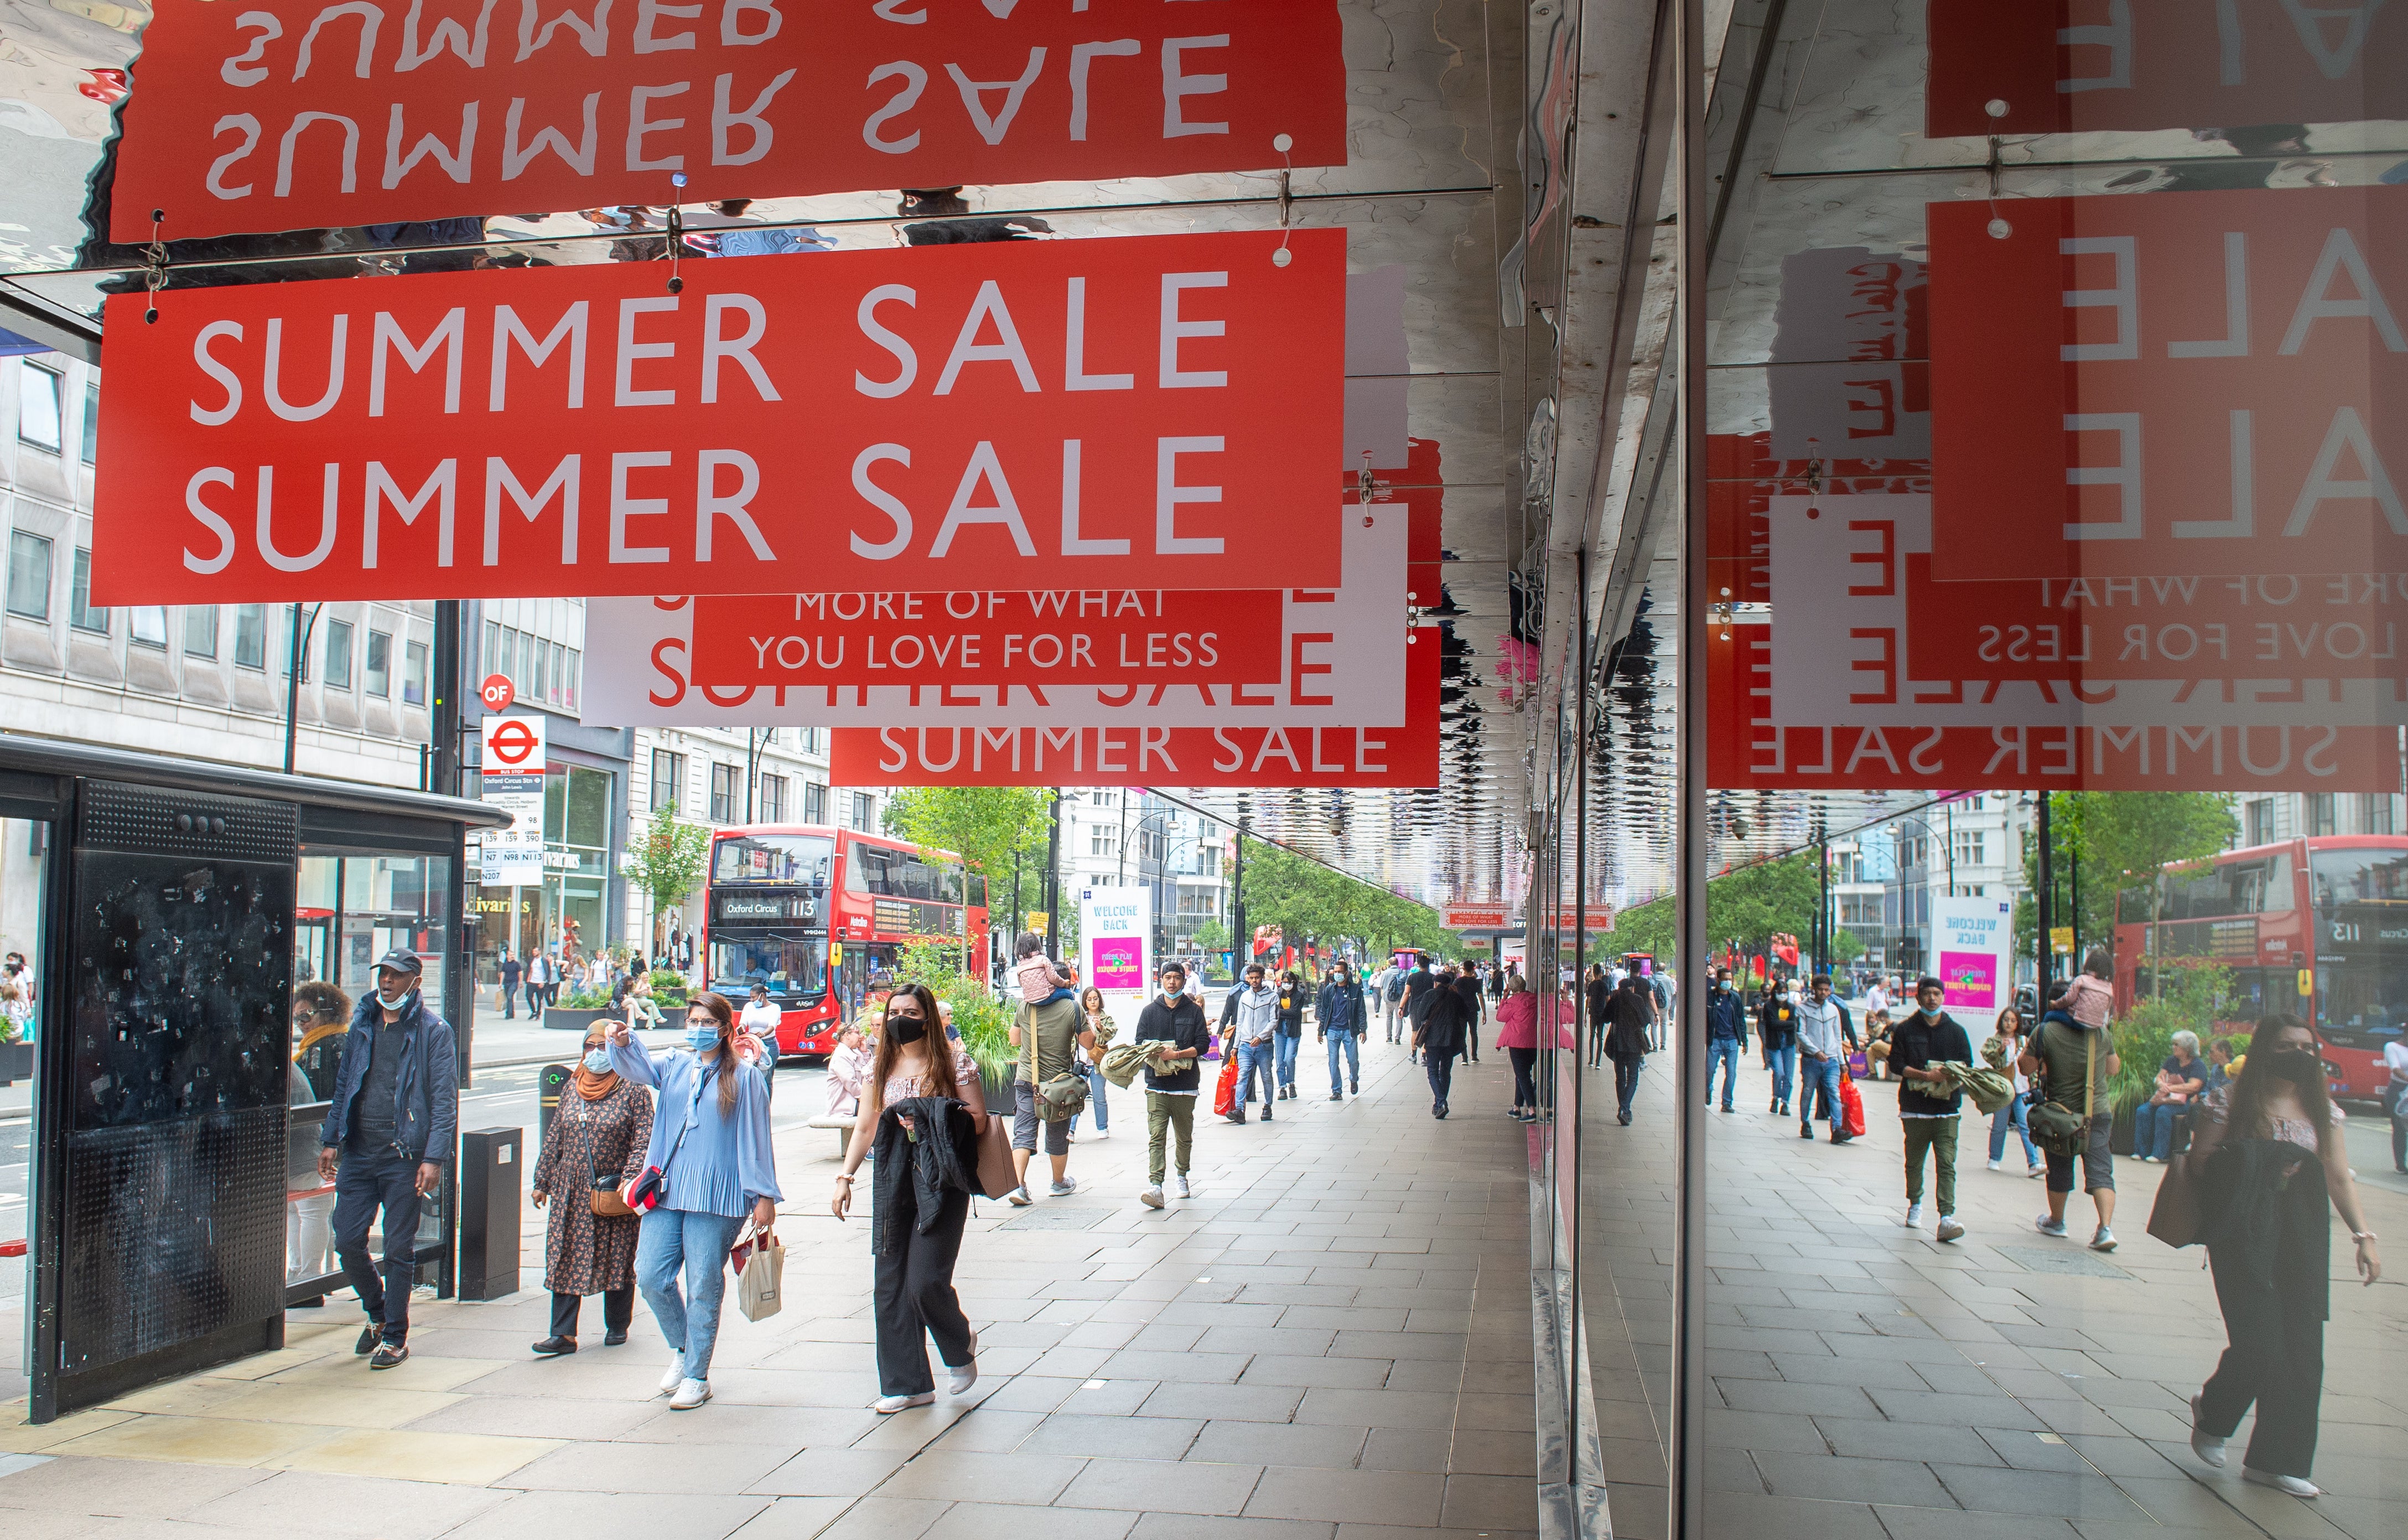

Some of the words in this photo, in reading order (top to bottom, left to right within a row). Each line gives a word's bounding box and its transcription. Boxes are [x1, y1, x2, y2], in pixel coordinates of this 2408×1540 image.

[190, 293, 783, 426] SUMMER
[855, 271, 1228, 399] SALE
[184, 449, 777, 575] SUMMER
[850, 436, 1225, 560] SALE
[795, 592, 923, 620] MORE
[945, 591, 1005, 619] OF
[1027, 590, 1163, 618] WHAT
[749, 636, 844, 669] YOU
[868, 634, 981, 668] LOVE
[1003, 633, 1096, 668] FOR
[1119, 632, 1217, 667] LESS
[485, 685, 508, 702] OF
[879, 727, 1179, 772] SUMMER
[1212, 727, 1388, 772] SALE
[728, 904, 754, 913] Oxford
[755, 904, 777, 913] Circus
[793, 901, 814, 917] 113
[1094, 905, 1138, 917] WELCOME
[1103, 920, 1128, 930] BACK
